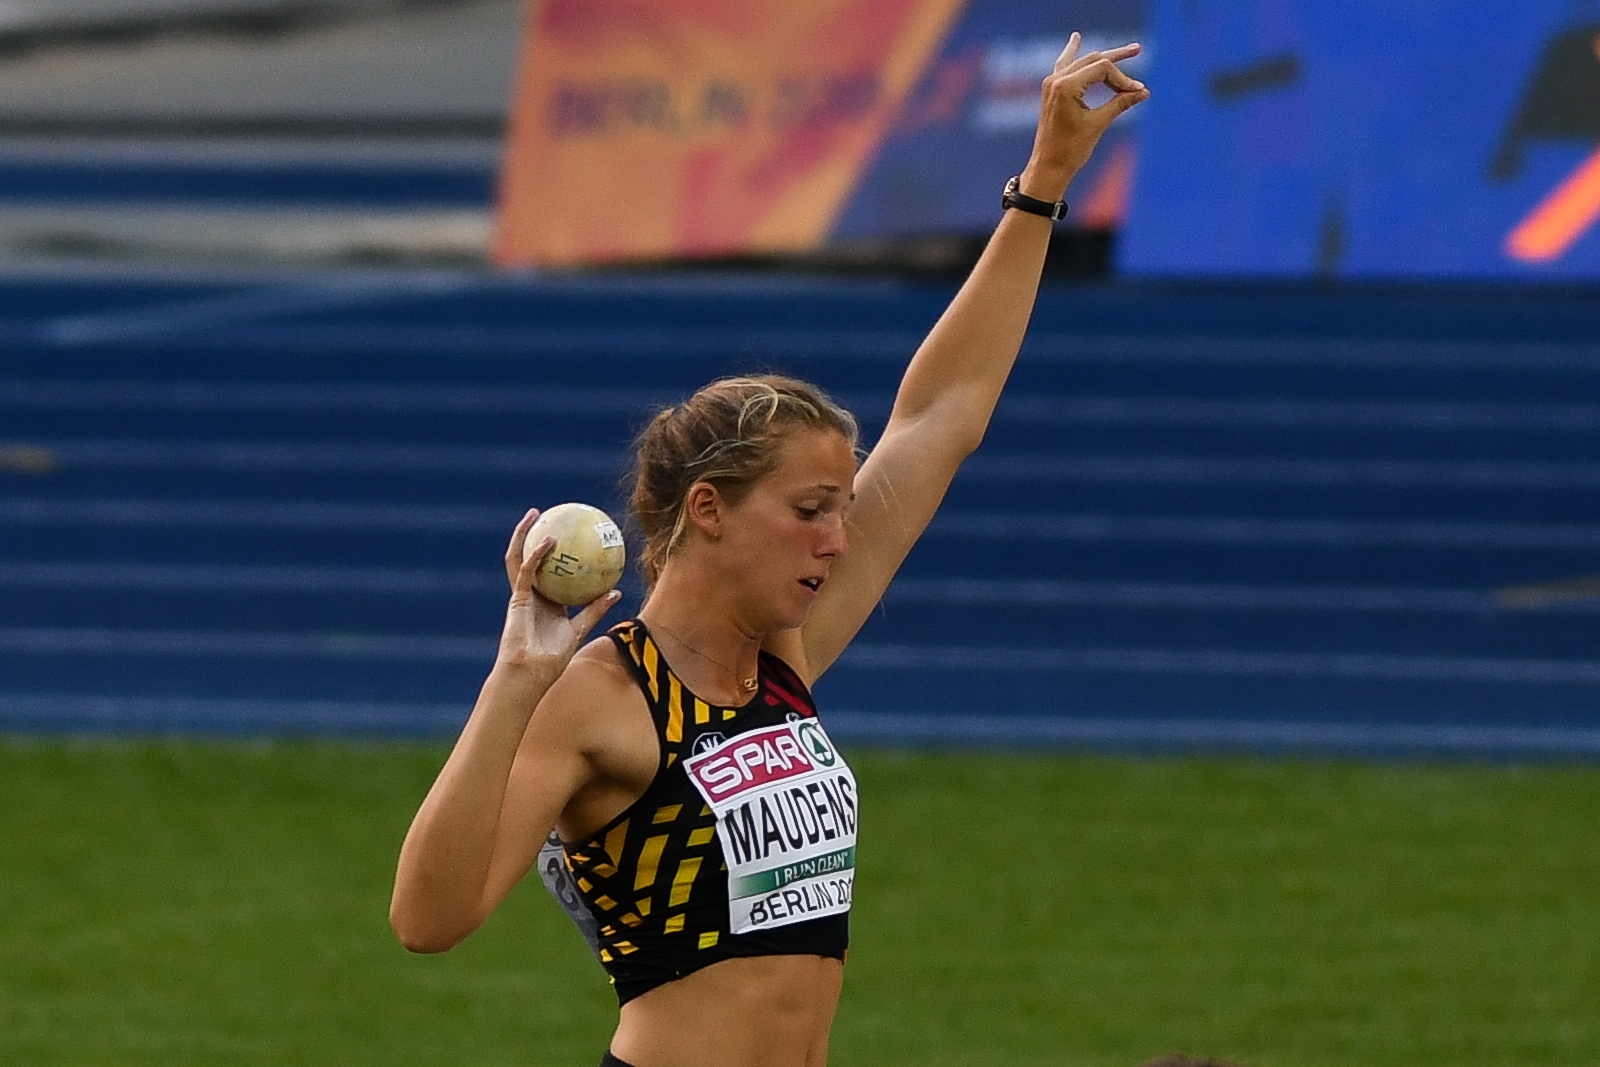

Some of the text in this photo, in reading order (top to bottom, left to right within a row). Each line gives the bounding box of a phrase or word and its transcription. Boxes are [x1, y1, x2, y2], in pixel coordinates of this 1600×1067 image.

[700, 735, 809, 795] SPAR
[725, 775, 855, 865] MAUDENS
[784, 860, 816, 883] RUN
[749, 881, 835, 926] BERLIN
